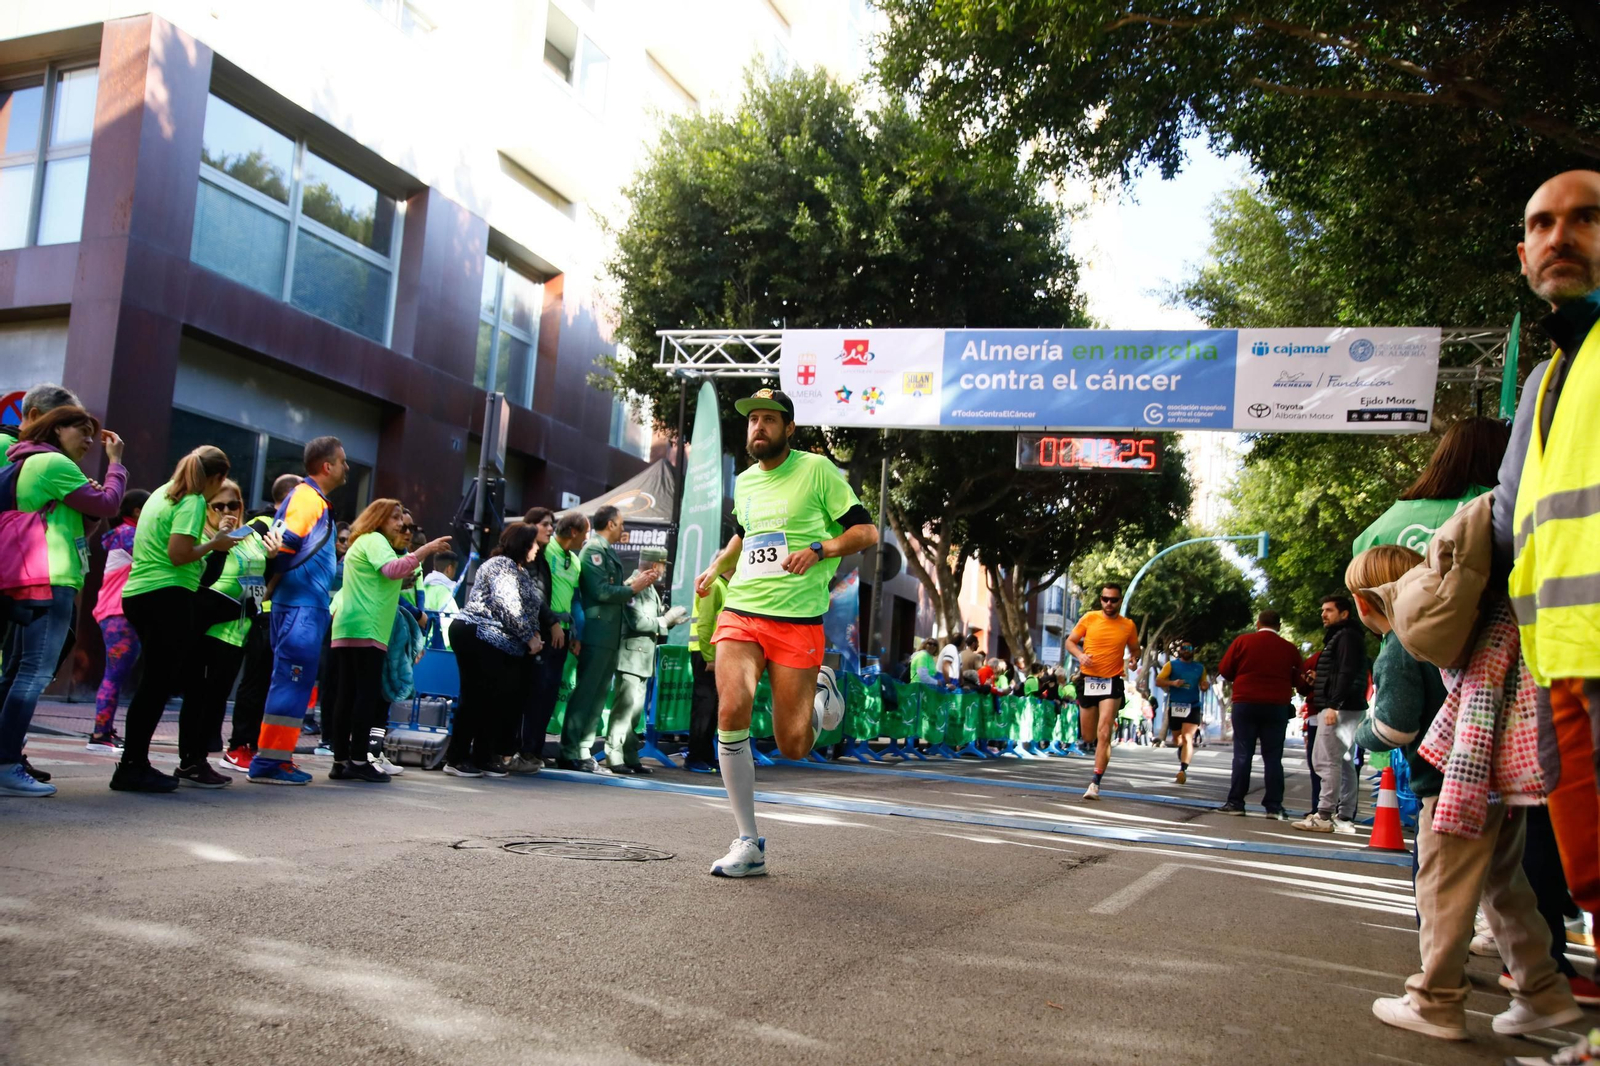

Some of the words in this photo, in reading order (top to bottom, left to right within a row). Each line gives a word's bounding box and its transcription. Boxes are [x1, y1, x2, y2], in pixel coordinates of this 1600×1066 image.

[960, 340, 1063, 361] Almería
[1072, 345, 1104, 361] en
[1114, 339, 1218, 361] marcha
[1273, 342, 1331, 357] cajamar
[960, 370, 1044, 390] contra
[1052, 369, 1077, 390] el
[1085, 369, 1182, 391] cáncer
[1327, 375, 1394, 388] Fundación
[1166, 403, 1199, 411] asociación
[1276, 403, 1304, 411] Toyota
[1360, 397, 1384, 407] Ejido
[1386, 397, 1416, 405] Motor
[951, 410, 1036, 419] #TodosContraElCáncer
[1309, 412, 1334, 420] Motor
[748, 547, 777, 565] 833
[249, 585, 264, 597] 153
[1090, 682, 1106, 690] 676
